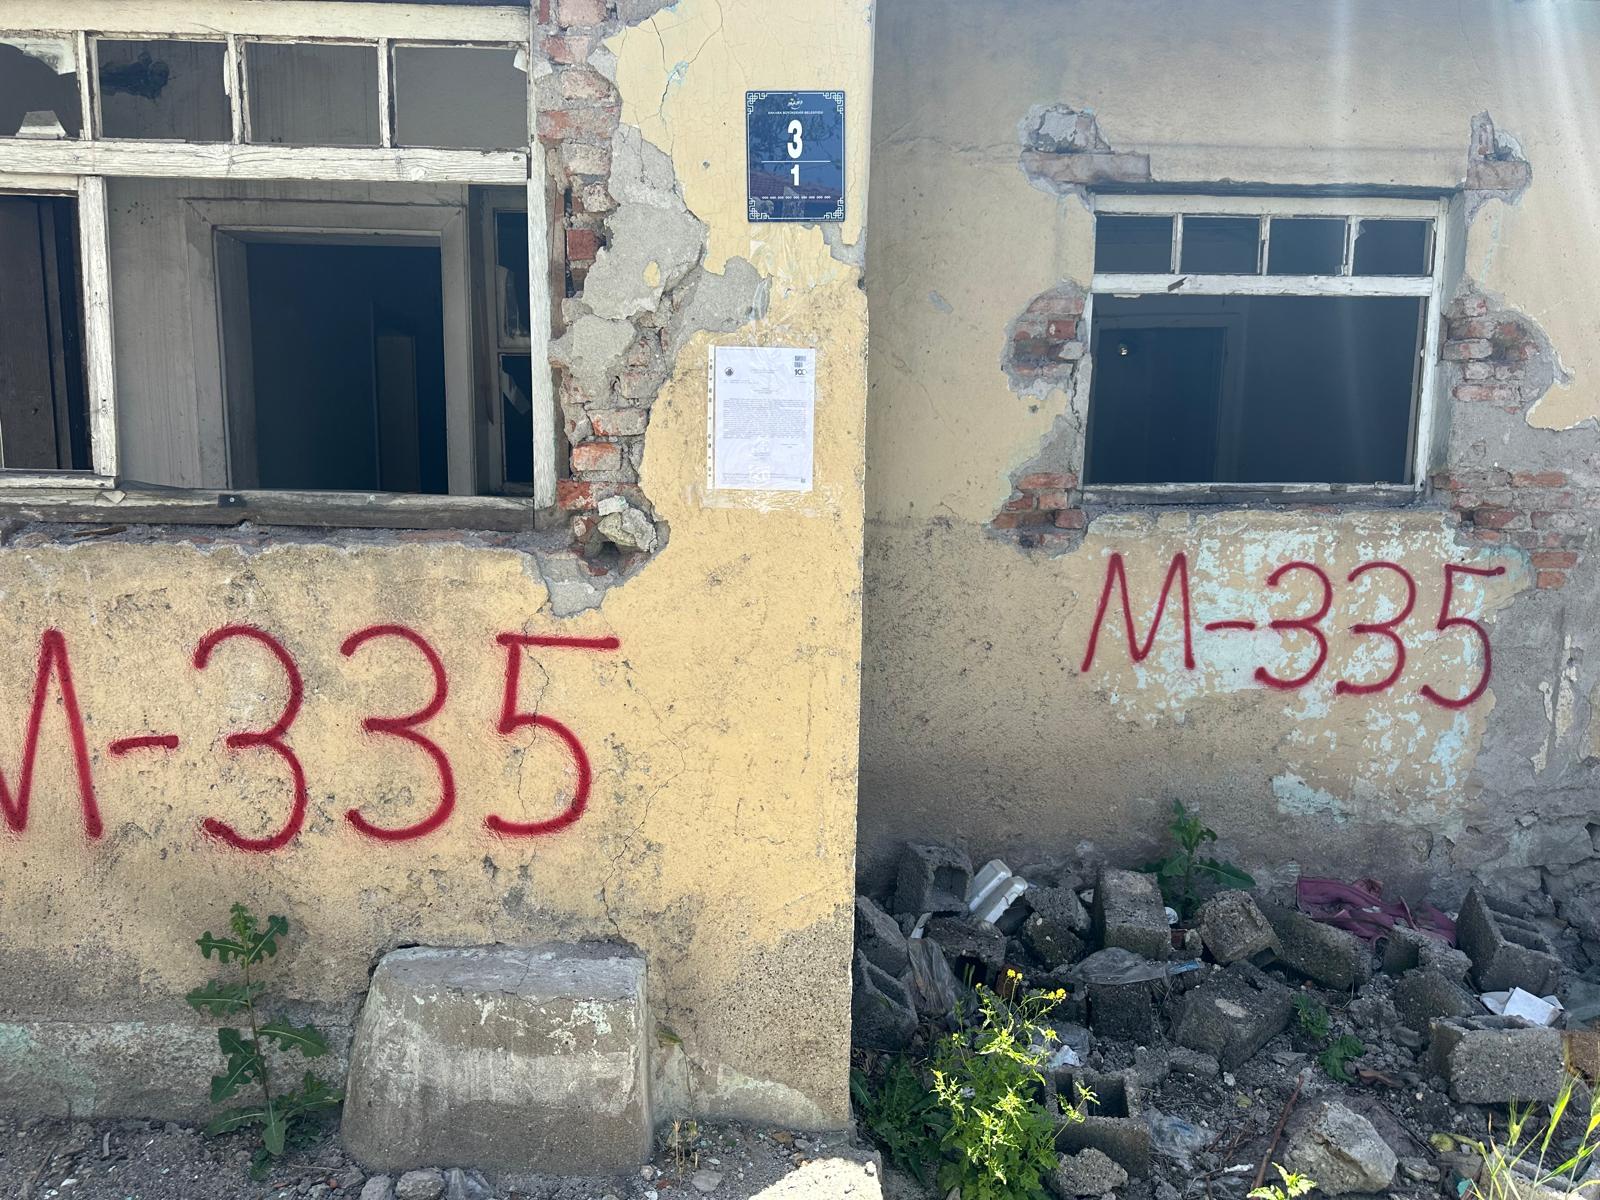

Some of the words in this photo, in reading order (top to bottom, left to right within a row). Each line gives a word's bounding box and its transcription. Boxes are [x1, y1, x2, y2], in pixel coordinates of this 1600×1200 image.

[787, 119, 803, 159] 3
[790, 164, 800, 186] 1
[1080, 552, 1506, 710] M-335
